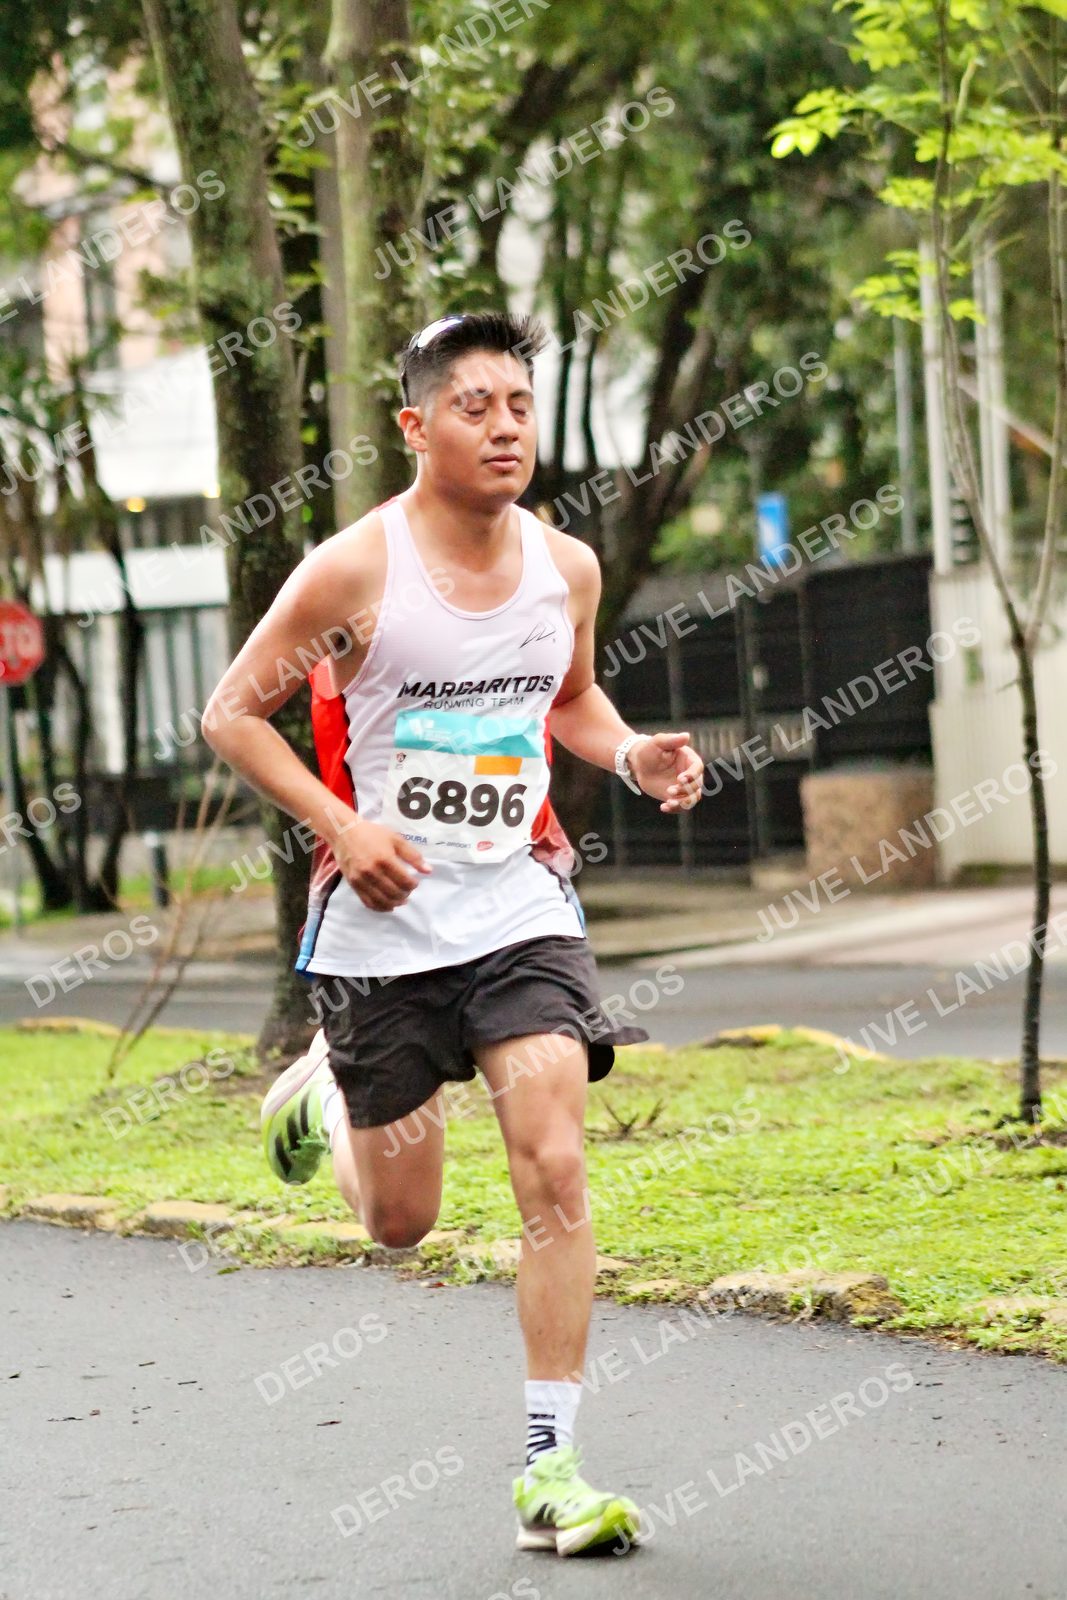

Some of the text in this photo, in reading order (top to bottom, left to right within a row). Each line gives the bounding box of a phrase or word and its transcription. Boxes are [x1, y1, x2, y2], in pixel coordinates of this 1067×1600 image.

[397, 675, 554, 698] MARGARITO'S
[423, 697, 524, 710] RUNNING TEAM
[397, 777, 527, 827] 6896
